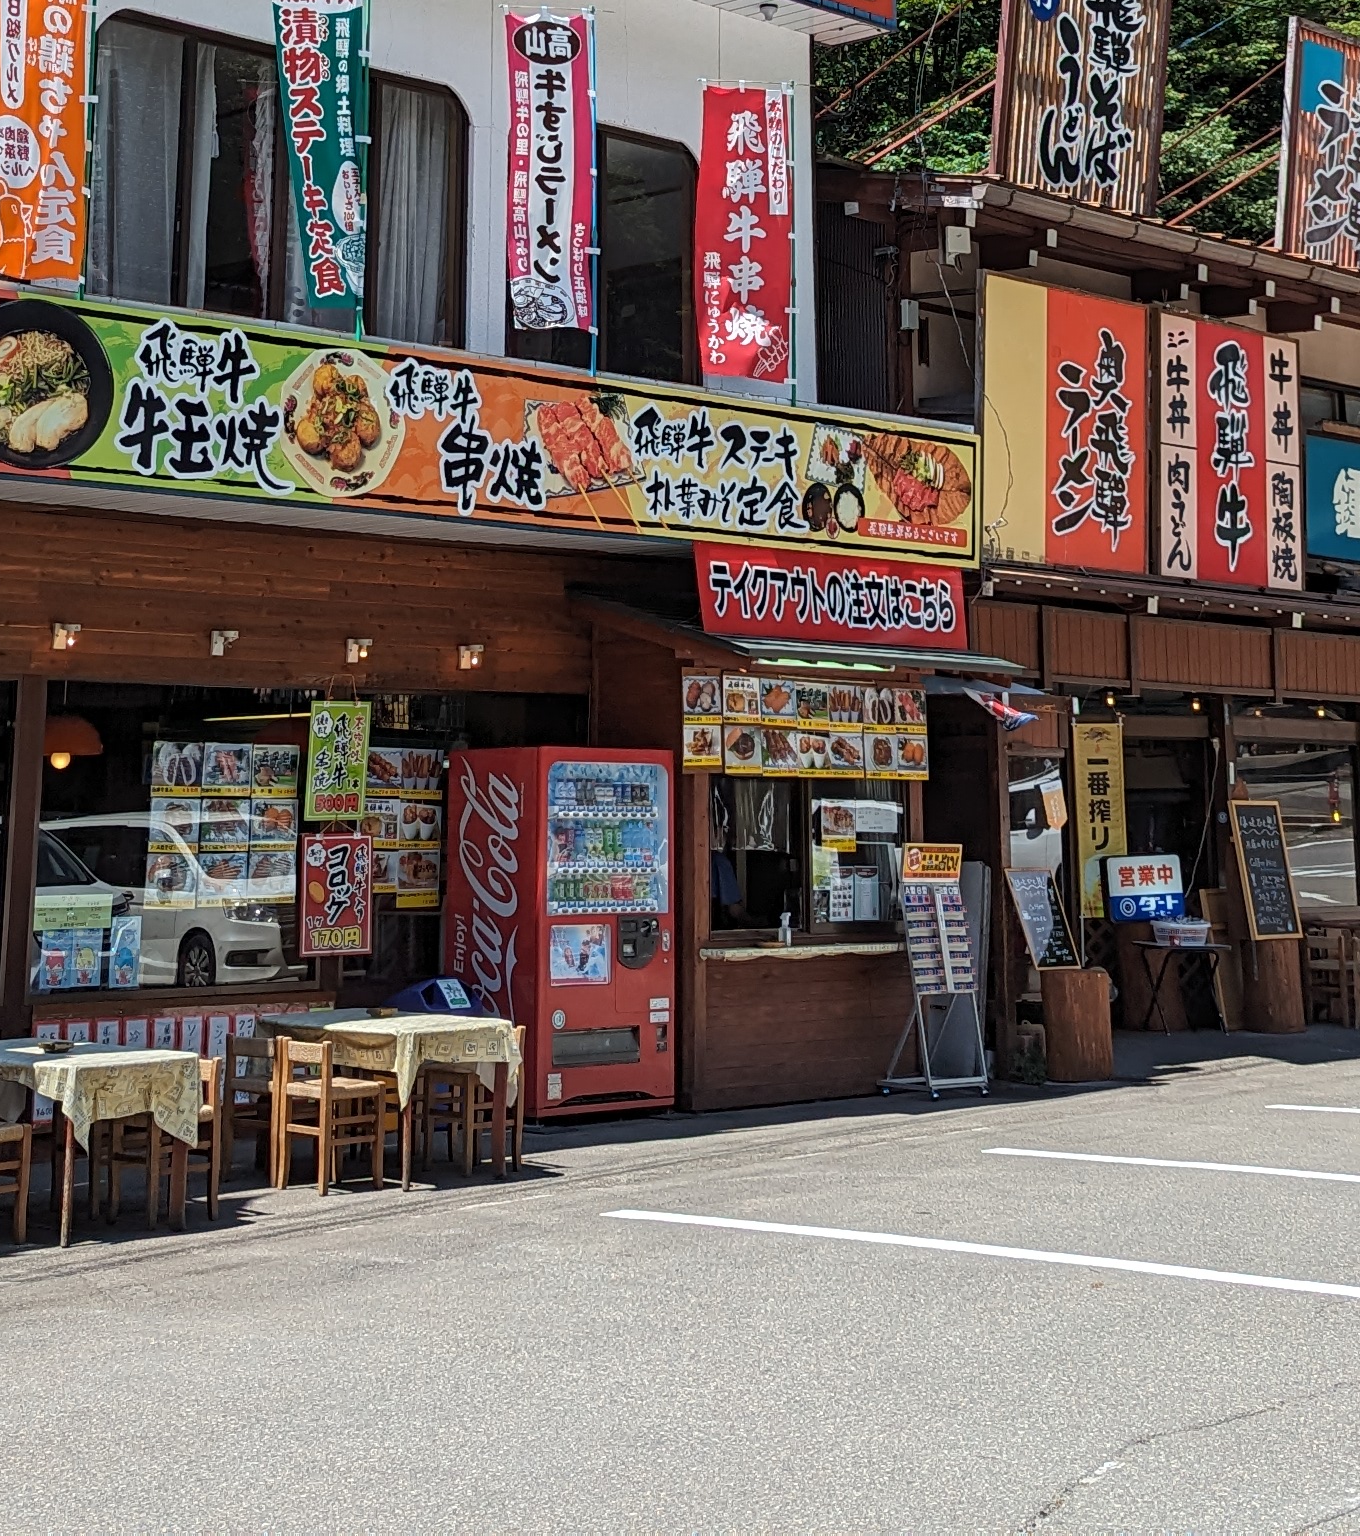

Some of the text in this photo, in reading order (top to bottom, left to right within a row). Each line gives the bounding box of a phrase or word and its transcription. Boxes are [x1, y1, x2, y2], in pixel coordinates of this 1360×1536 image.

[335, 16, 357, 159] 飛騨の郷土料理
[1040, 11, 1086, 188] うどん
[281, 6, 346, 300] 漬物ステーキ定食
[1304, 77, 1350, 247] ラーメン
[722, 110, 772, 347] 飛騨牛串焼
[141, 322, 258, 402] 飛騨牛
[388, 359, 479, 420] 飛騨牛
[1166, 330, 1190, 439] ミニ牛丼
[1269, 348, 1294, 454] 牛丼
[119, 384, 294, 493] 牛玉焼
[441, 419, 544, 512] 串焼
[633, 405, 799, 478] 飛騨牛ステーキ
[1052, 361, 1094, 536] ラーメン
[1090, 328, 1134, 551] 奥飛騨
[1209, 340, 1254, 572] 飛騨牛
[646, 475, 807, 532] 朴葉みそ定食
[1166, 453, 1192, 573] 肉うどん
[1271, 471, 1298, 582] 陶板焼
[709, 565, 958, 632] テイクアウトの注文はこちら
[330, 713, 351, 790] 飛騨牛
[314, 792, 360, 813] 500円
[1086, 757, 1112, 852] 一番搾り
[325, 843, 352, 926] コロッケ
[459, 755, 521, 1019] oca-Cola
[1117, 863, 1174, 889] 営業中
[1138, 895, 1180, 912] ダート
[311, 926, 361, 950] 170円
[453, 913, 468, 974] Enjoy!
